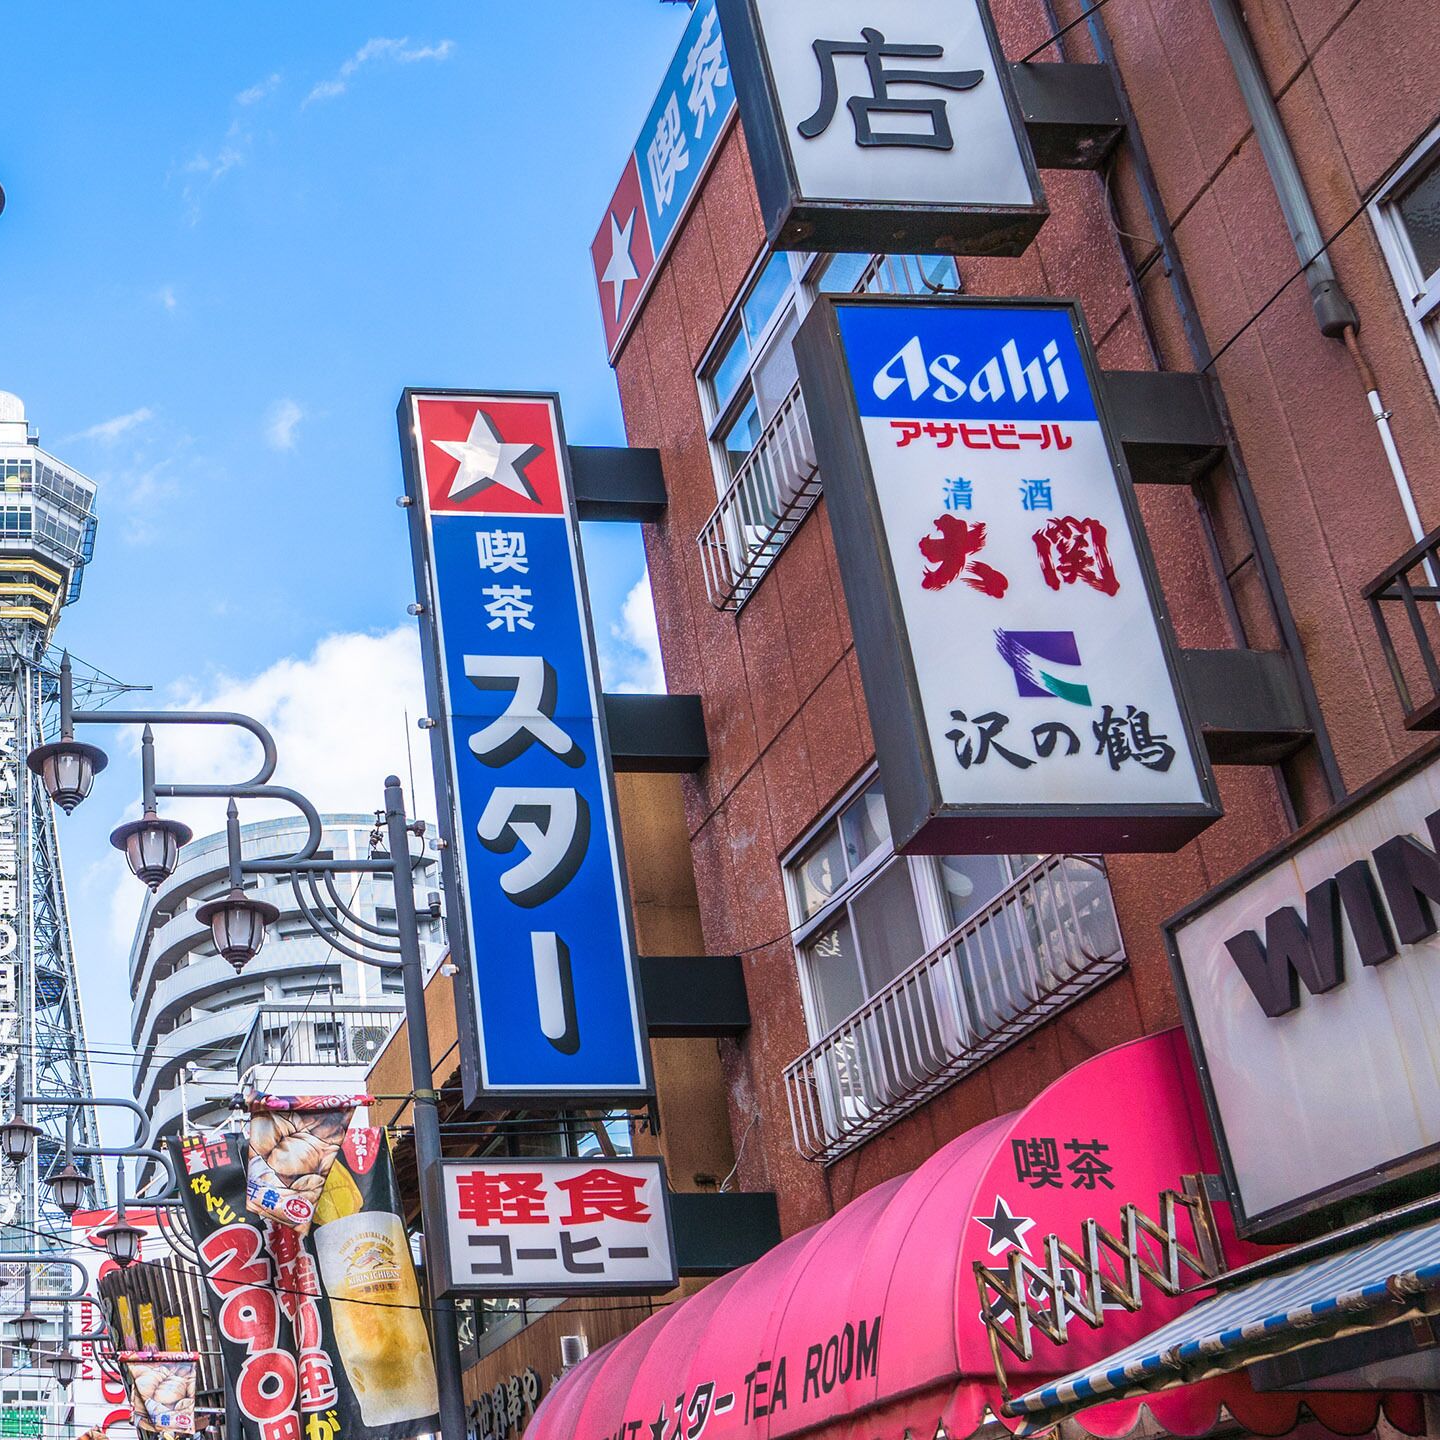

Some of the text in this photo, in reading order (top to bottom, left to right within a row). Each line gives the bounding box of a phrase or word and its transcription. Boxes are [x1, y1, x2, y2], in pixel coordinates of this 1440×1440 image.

[797, 27, 985, 151] 店
[872, 335, 1070, 403] Asahi
[890, 421, 1072, 451] アサヒビール
[942, 477, 1054, 512] 清酒
[476, 530, 537, 633] 喫茶
[918, 513, 1121, 599] 大関
[944, 705, 1177, 773] 沢の鶴
[463, 654, 590, 1055] スター
[456, 1168, 652, 1228] 軽食
[1012, 1137, 1116, 1191] 喫茶
[468, 1232, 649, 1276] コーヒー
[744, 1356, 788, 1426] TEA
[802, 1316, 881, 1404] ROOM
